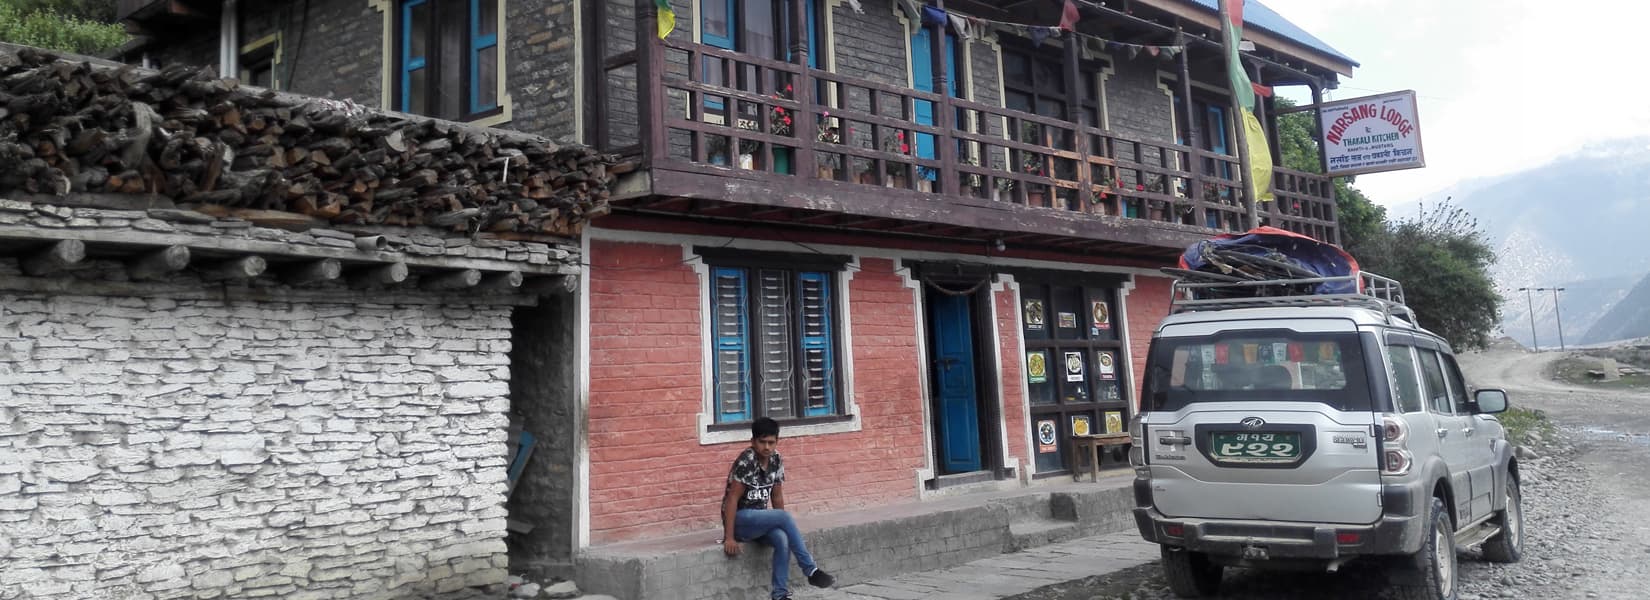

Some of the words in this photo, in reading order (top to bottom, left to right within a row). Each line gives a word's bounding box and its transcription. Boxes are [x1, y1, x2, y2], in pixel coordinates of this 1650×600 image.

[1326, 104, 1377, 145] NARSANG
[1380, 105, 1413, 138] LODGE
[1343, 134, 1371, 147] THAKALI
[1372, 131, 1399, 143] KITCHEN
